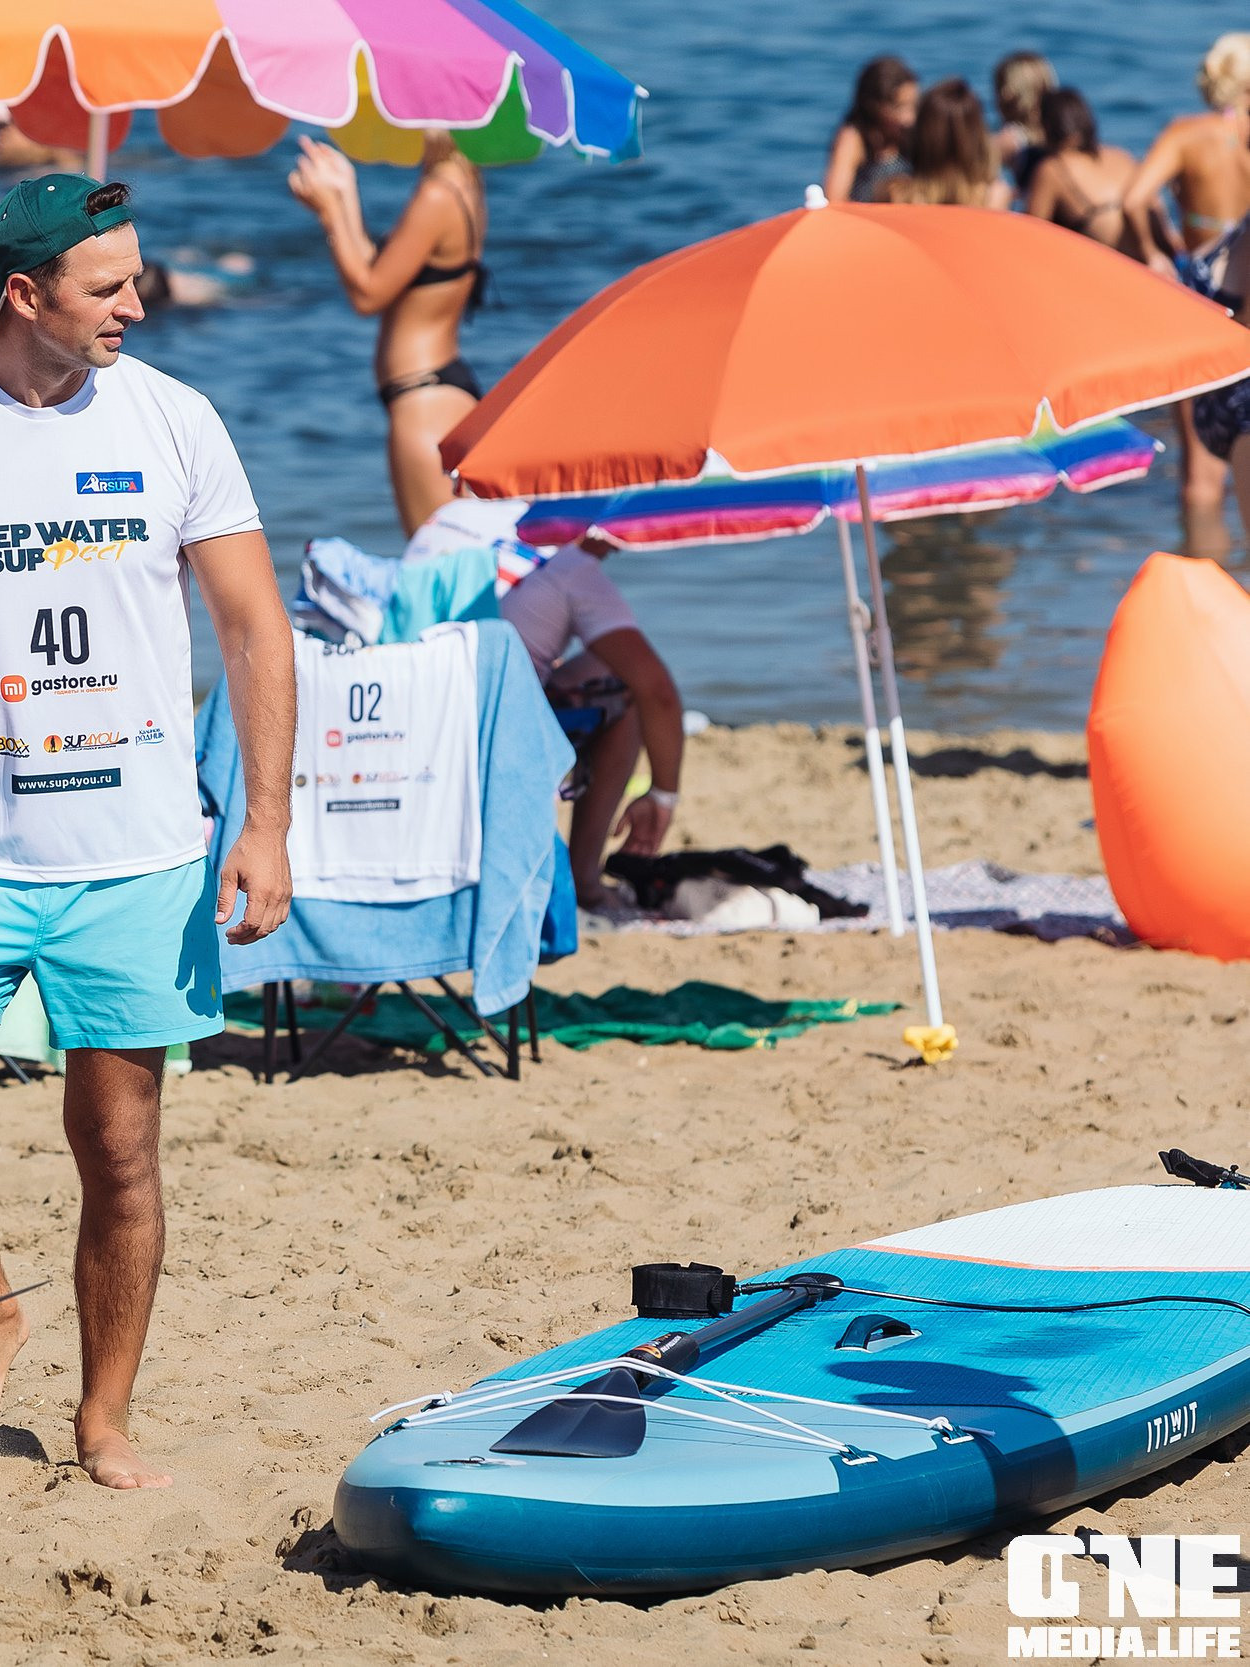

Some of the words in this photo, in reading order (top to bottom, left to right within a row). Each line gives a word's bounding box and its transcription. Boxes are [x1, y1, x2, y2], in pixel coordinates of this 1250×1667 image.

[35, 518, 150, 546] WATER
[30, 606, 91, 666] 40
[31, 673, 118, 696] gastore.ru
[349, 683, 383, 723] 02
[63, 731, 120, 748] SUP4YOU
[18, 774, 112, 790] www.sup4you.ru
[1146, 1401, 1198, 1453] ITIWIT
